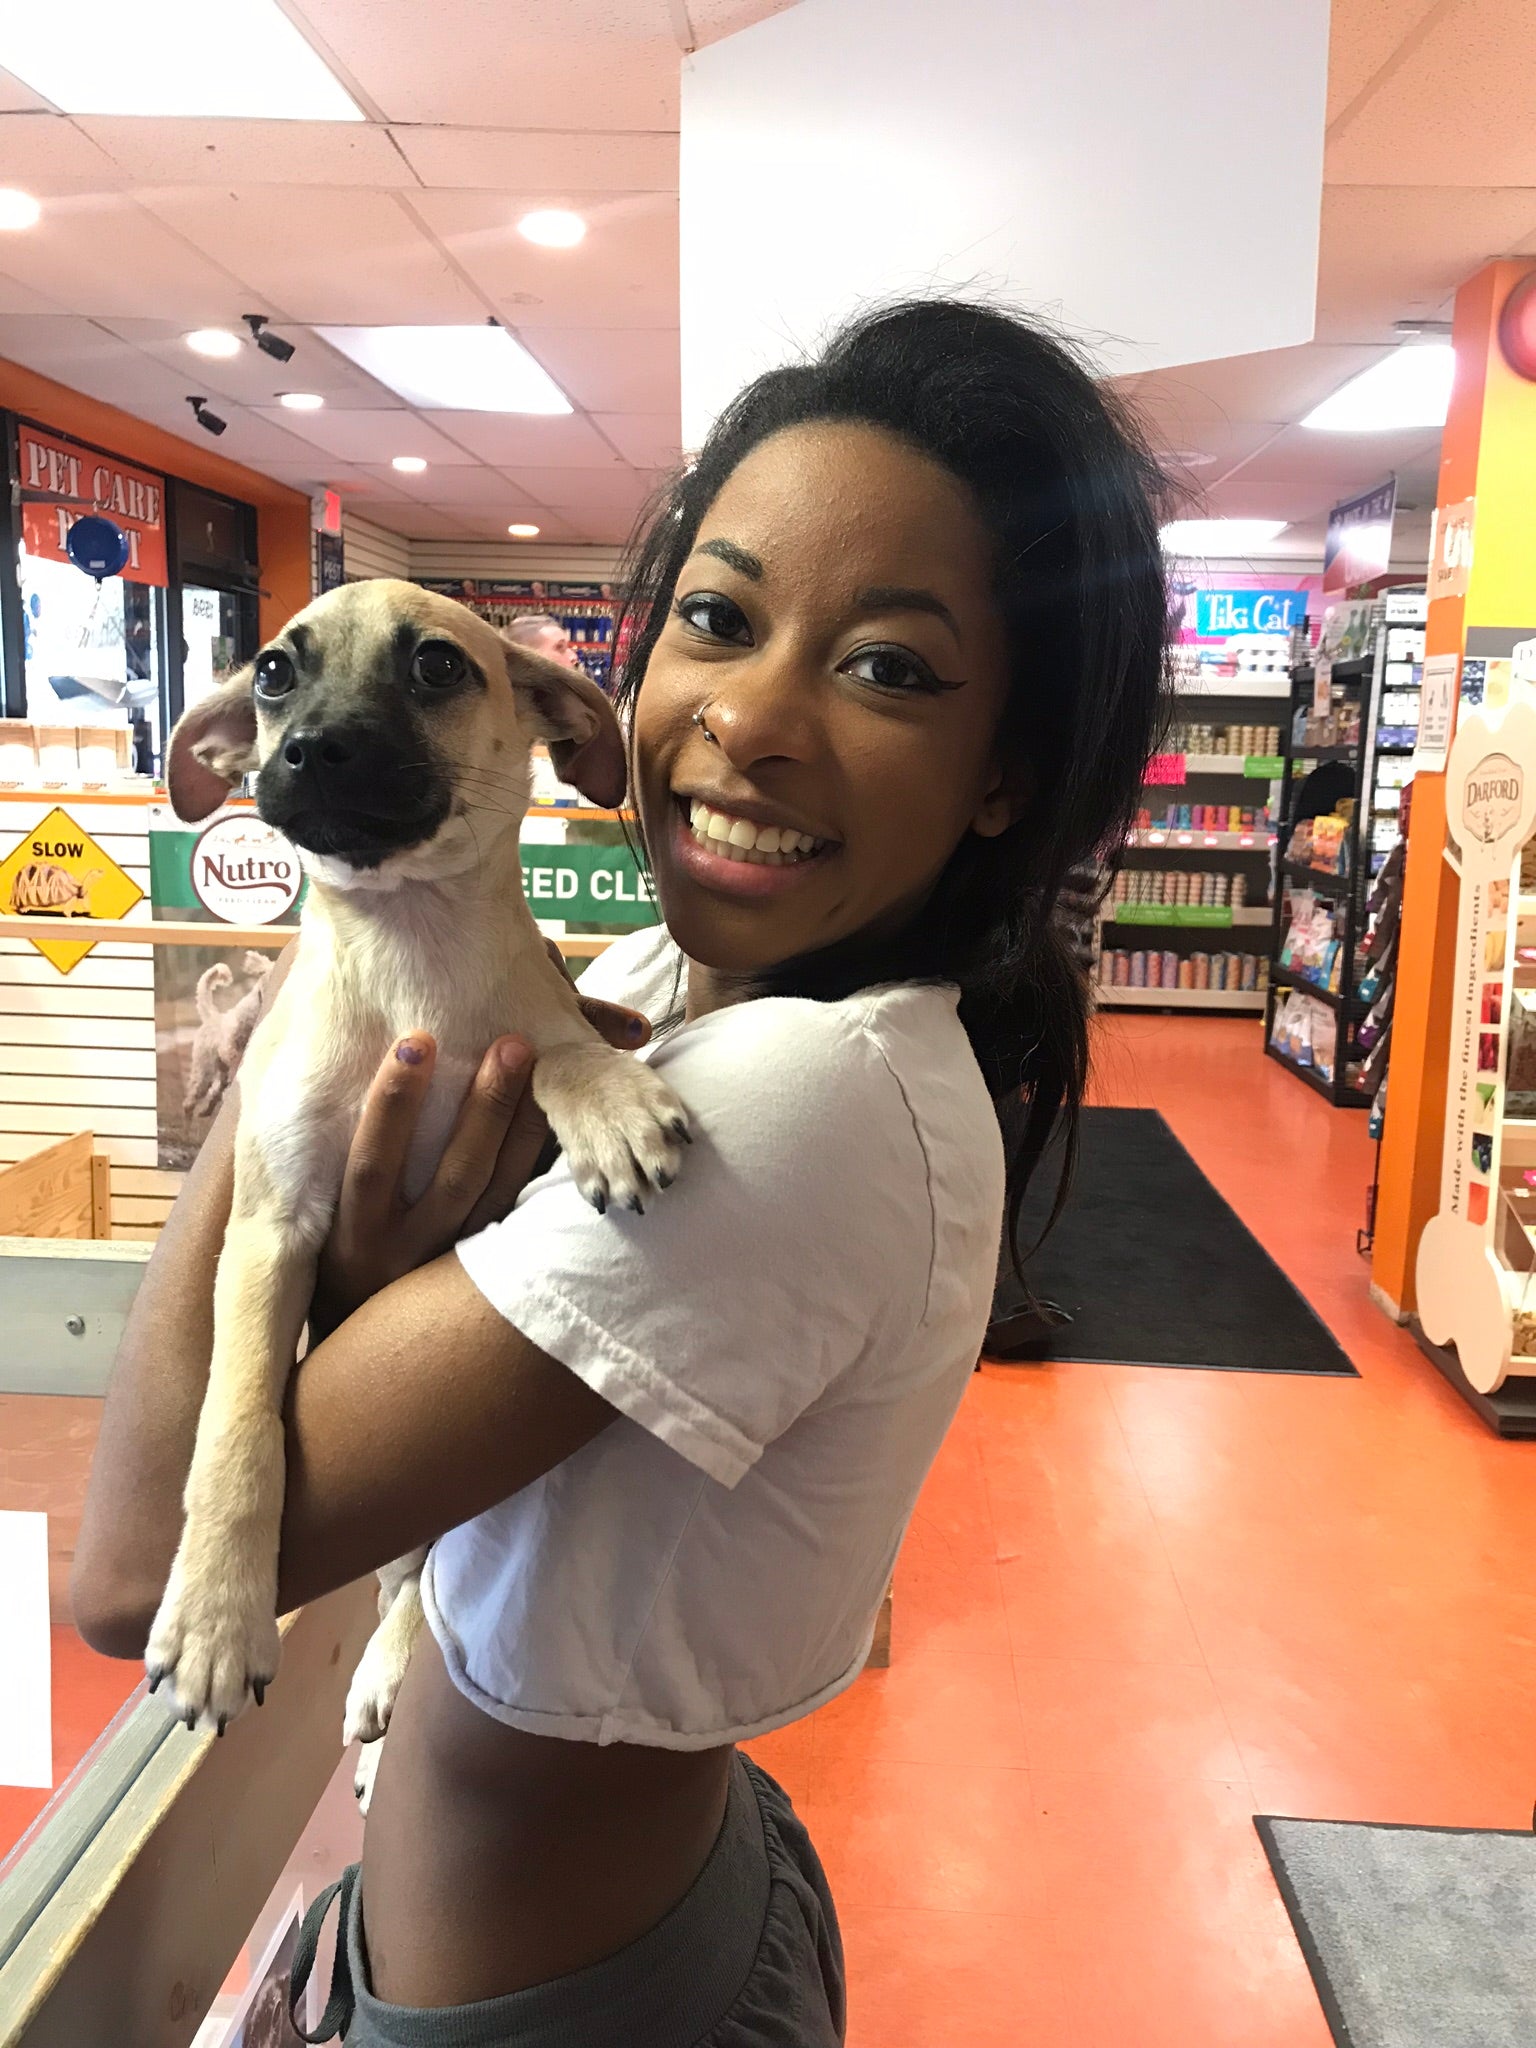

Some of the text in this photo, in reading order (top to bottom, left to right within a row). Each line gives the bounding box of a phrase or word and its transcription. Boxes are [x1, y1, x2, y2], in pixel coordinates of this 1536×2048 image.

[28, 441, 160, 526] PET CARE
[1205, 594, 1293, 632] Tiki Cat
[1467, 778, 1519, 808] DARFORD
[32, 841, 84, 858] SLOW
[202, 853, 292, 898] Nutro
[1450, 885, 1481, 1215] Made with the finest ingredients
